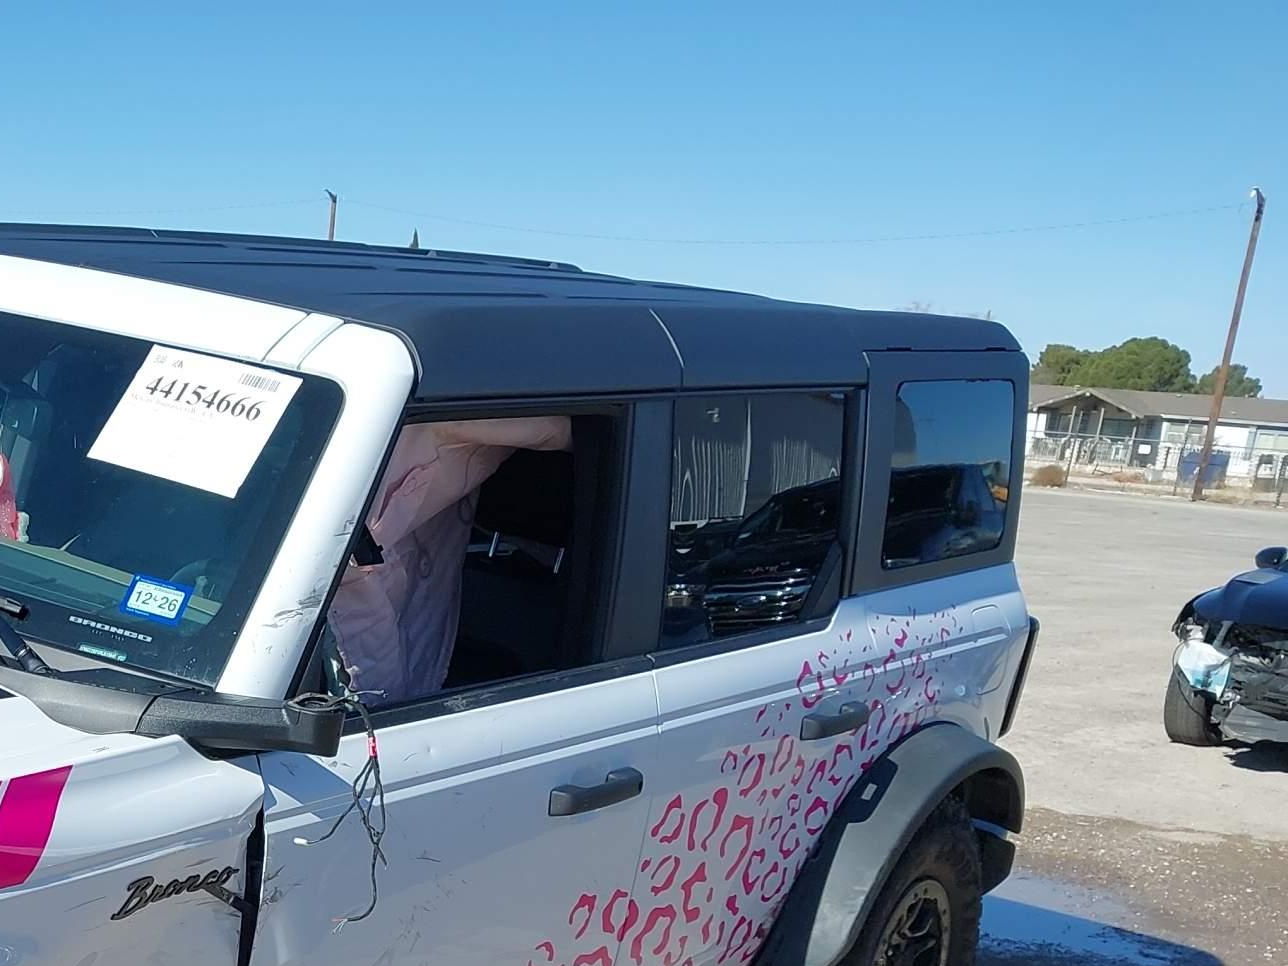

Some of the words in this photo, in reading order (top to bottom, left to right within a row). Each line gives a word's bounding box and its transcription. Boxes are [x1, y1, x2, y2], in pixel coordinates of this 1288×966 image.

[145, 376, 268, 422] 44154666
[68, 615, 153, 643] BRONCO
[110, 866, 240, 920] Bronco
